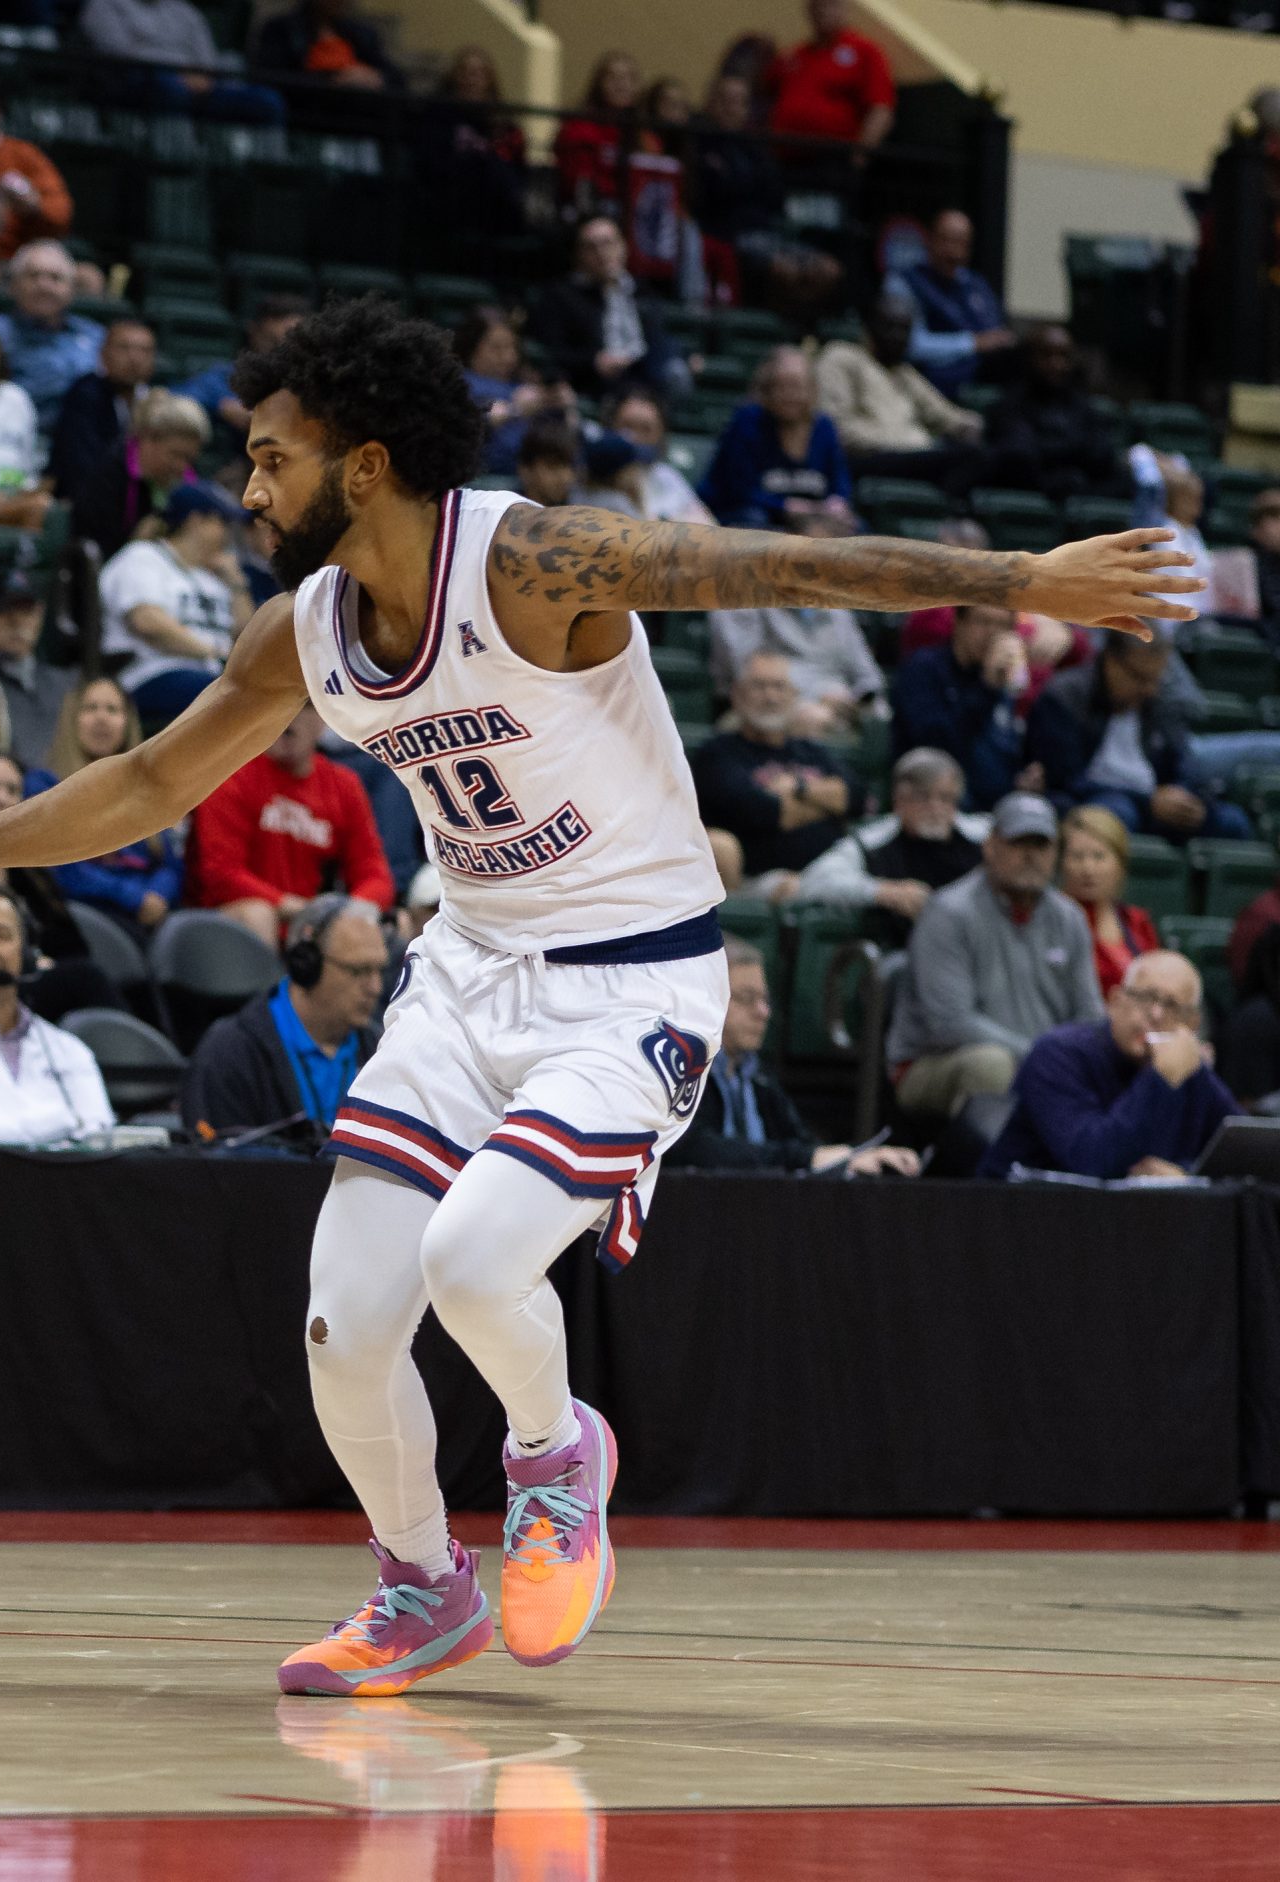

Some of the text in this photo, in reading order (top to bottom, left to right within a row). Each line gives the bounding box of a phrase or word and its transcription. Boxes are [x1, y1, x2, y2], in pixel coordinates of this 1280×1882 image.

[363, 705, 531, 768] FLORIDA
[418, 756, 525, 831] 12
[431, 802, 591, 877] ATLANTIC
